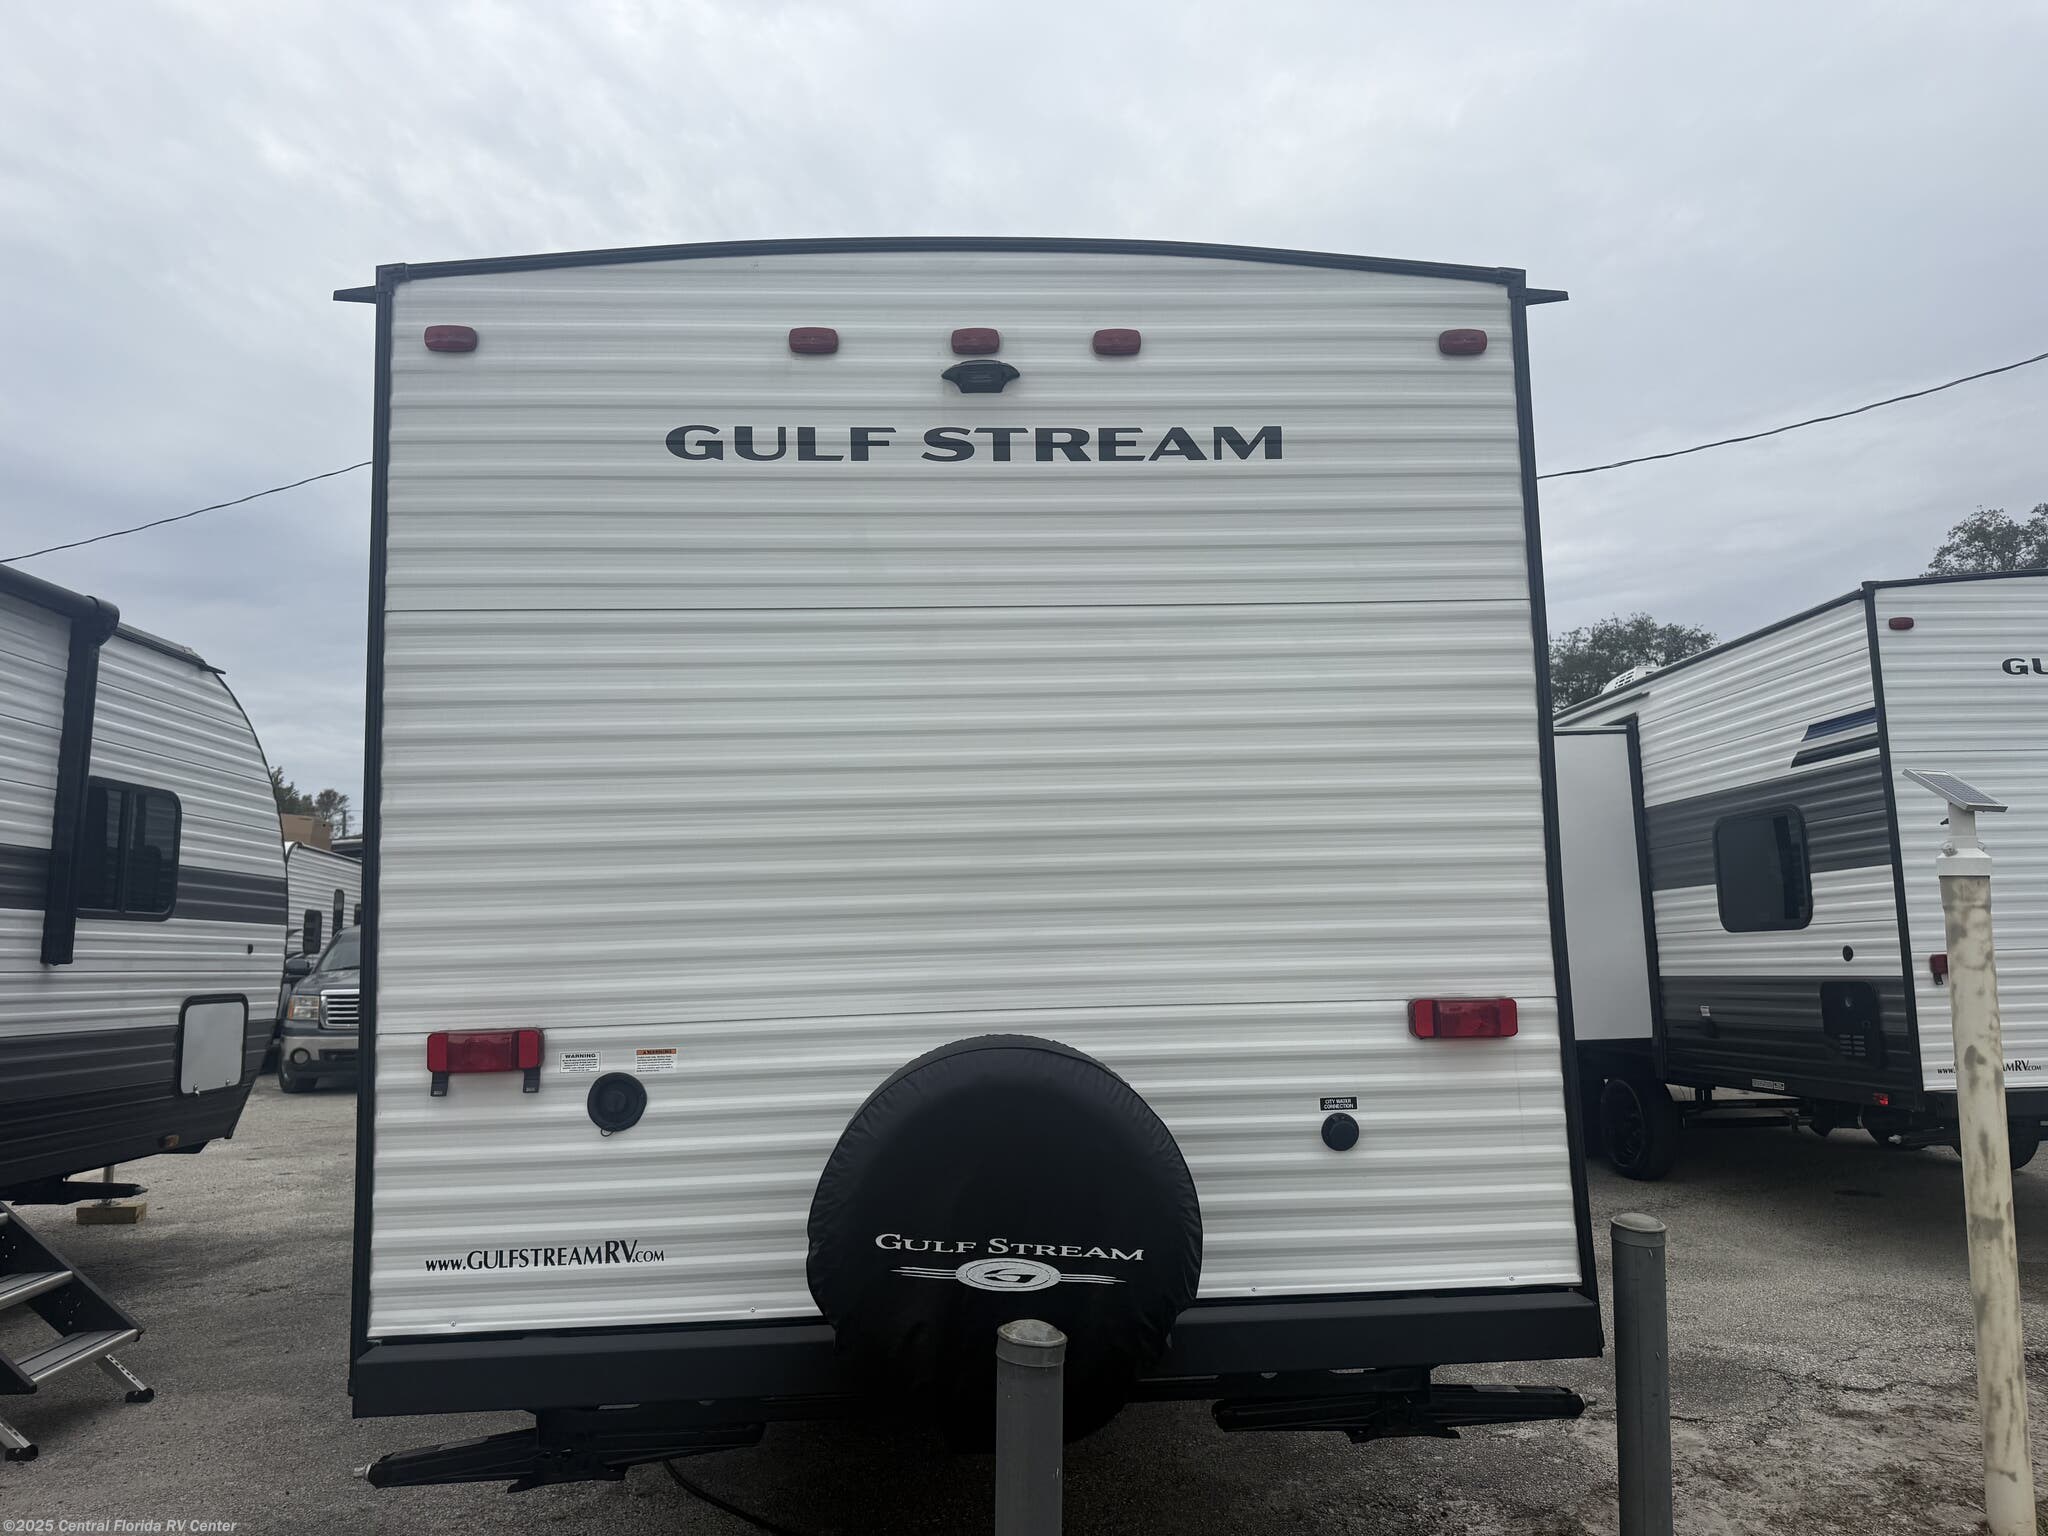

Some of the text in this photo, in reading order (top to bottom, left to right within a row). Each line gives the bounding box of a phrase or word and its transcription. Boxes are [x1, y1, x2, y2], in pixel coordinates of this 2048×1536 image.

[665, 424, 1283, 462] GULF STREAM
[875, 1233, 1144, 1261] GULF STREAM
